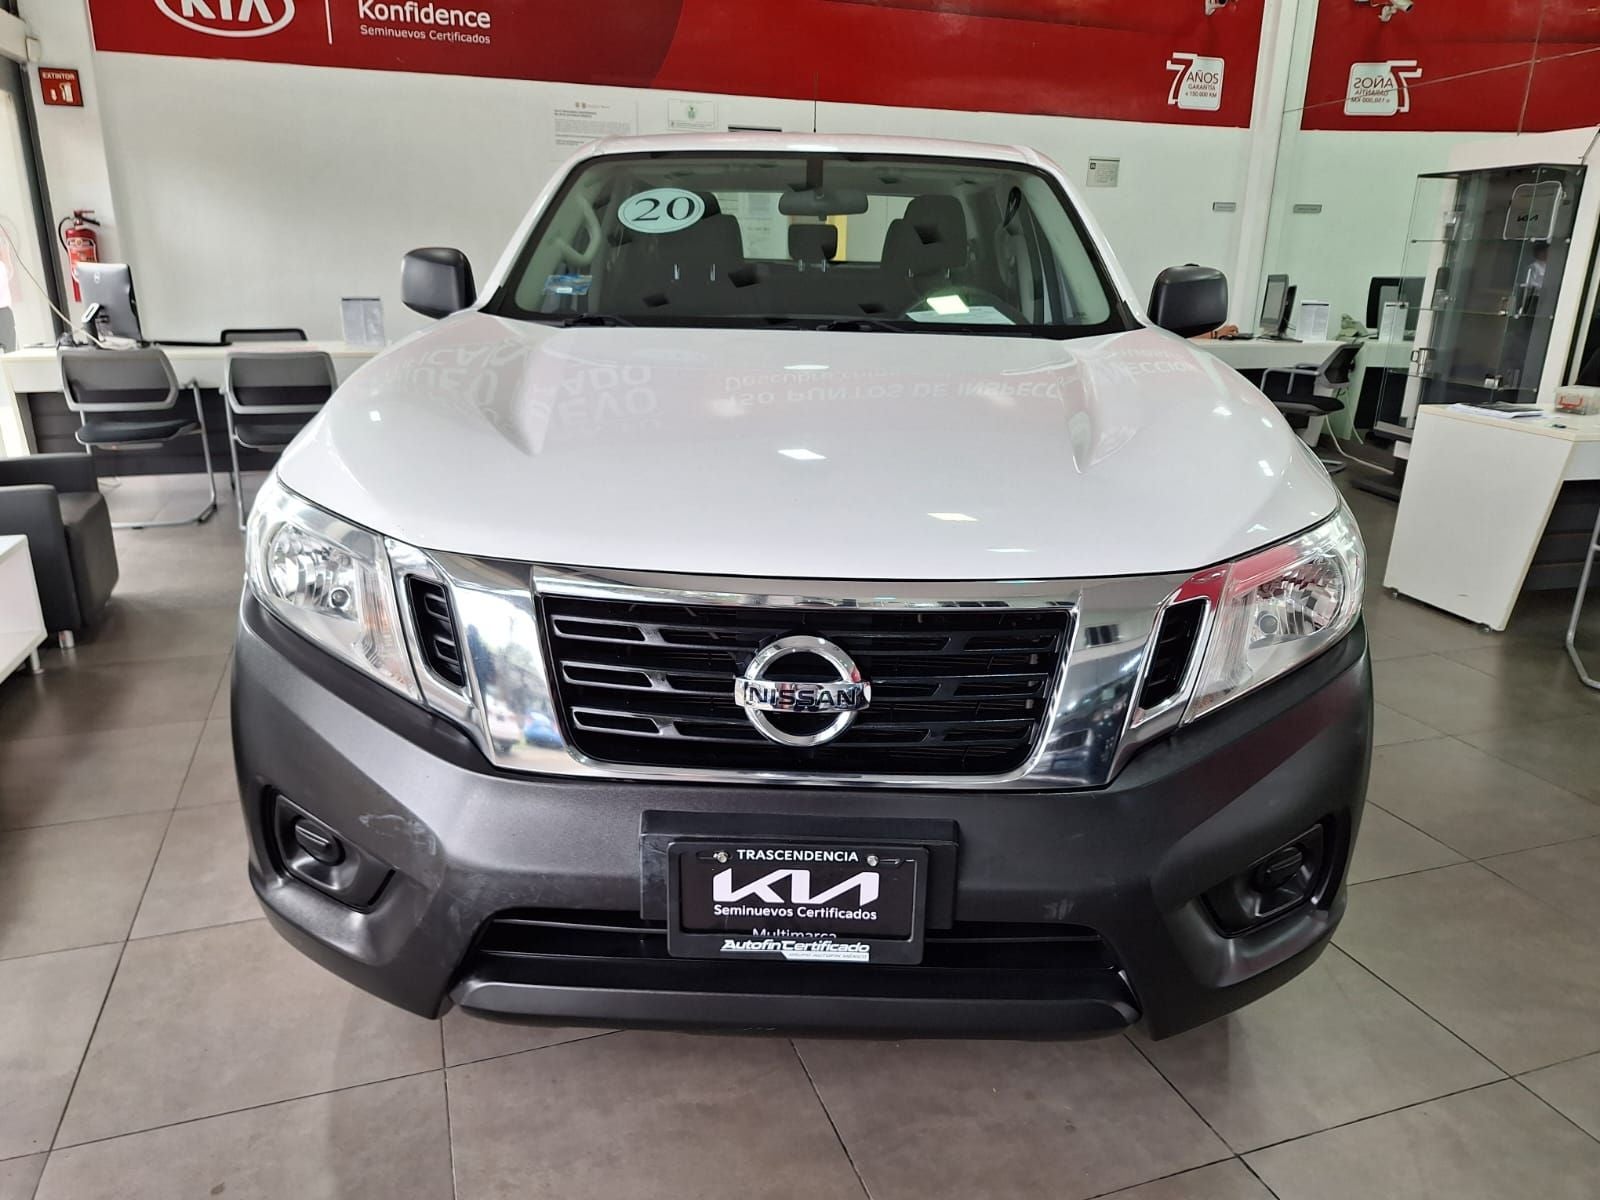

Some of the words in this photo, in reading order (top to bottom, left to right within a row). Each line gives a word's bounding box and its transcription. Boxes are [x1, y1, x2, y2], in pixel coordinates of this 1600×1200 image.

[358, 0, 491, 29] Konfidence
[360, 24, 426, 40] Seminuevos
[429, 29, 491, 45] Certificados
[1186, 69, 1219, 85] AÑOS
[632, 196, 696, 222] 20
[749, 687, 857, 706] NISSAN
[737, 849, 859, 862] TRASCENDENCIA
[713, 868, 879, 906] KIA
[714, 905, 793, 918] Seminuevos
[797, 907, 877, 920] Certificados
